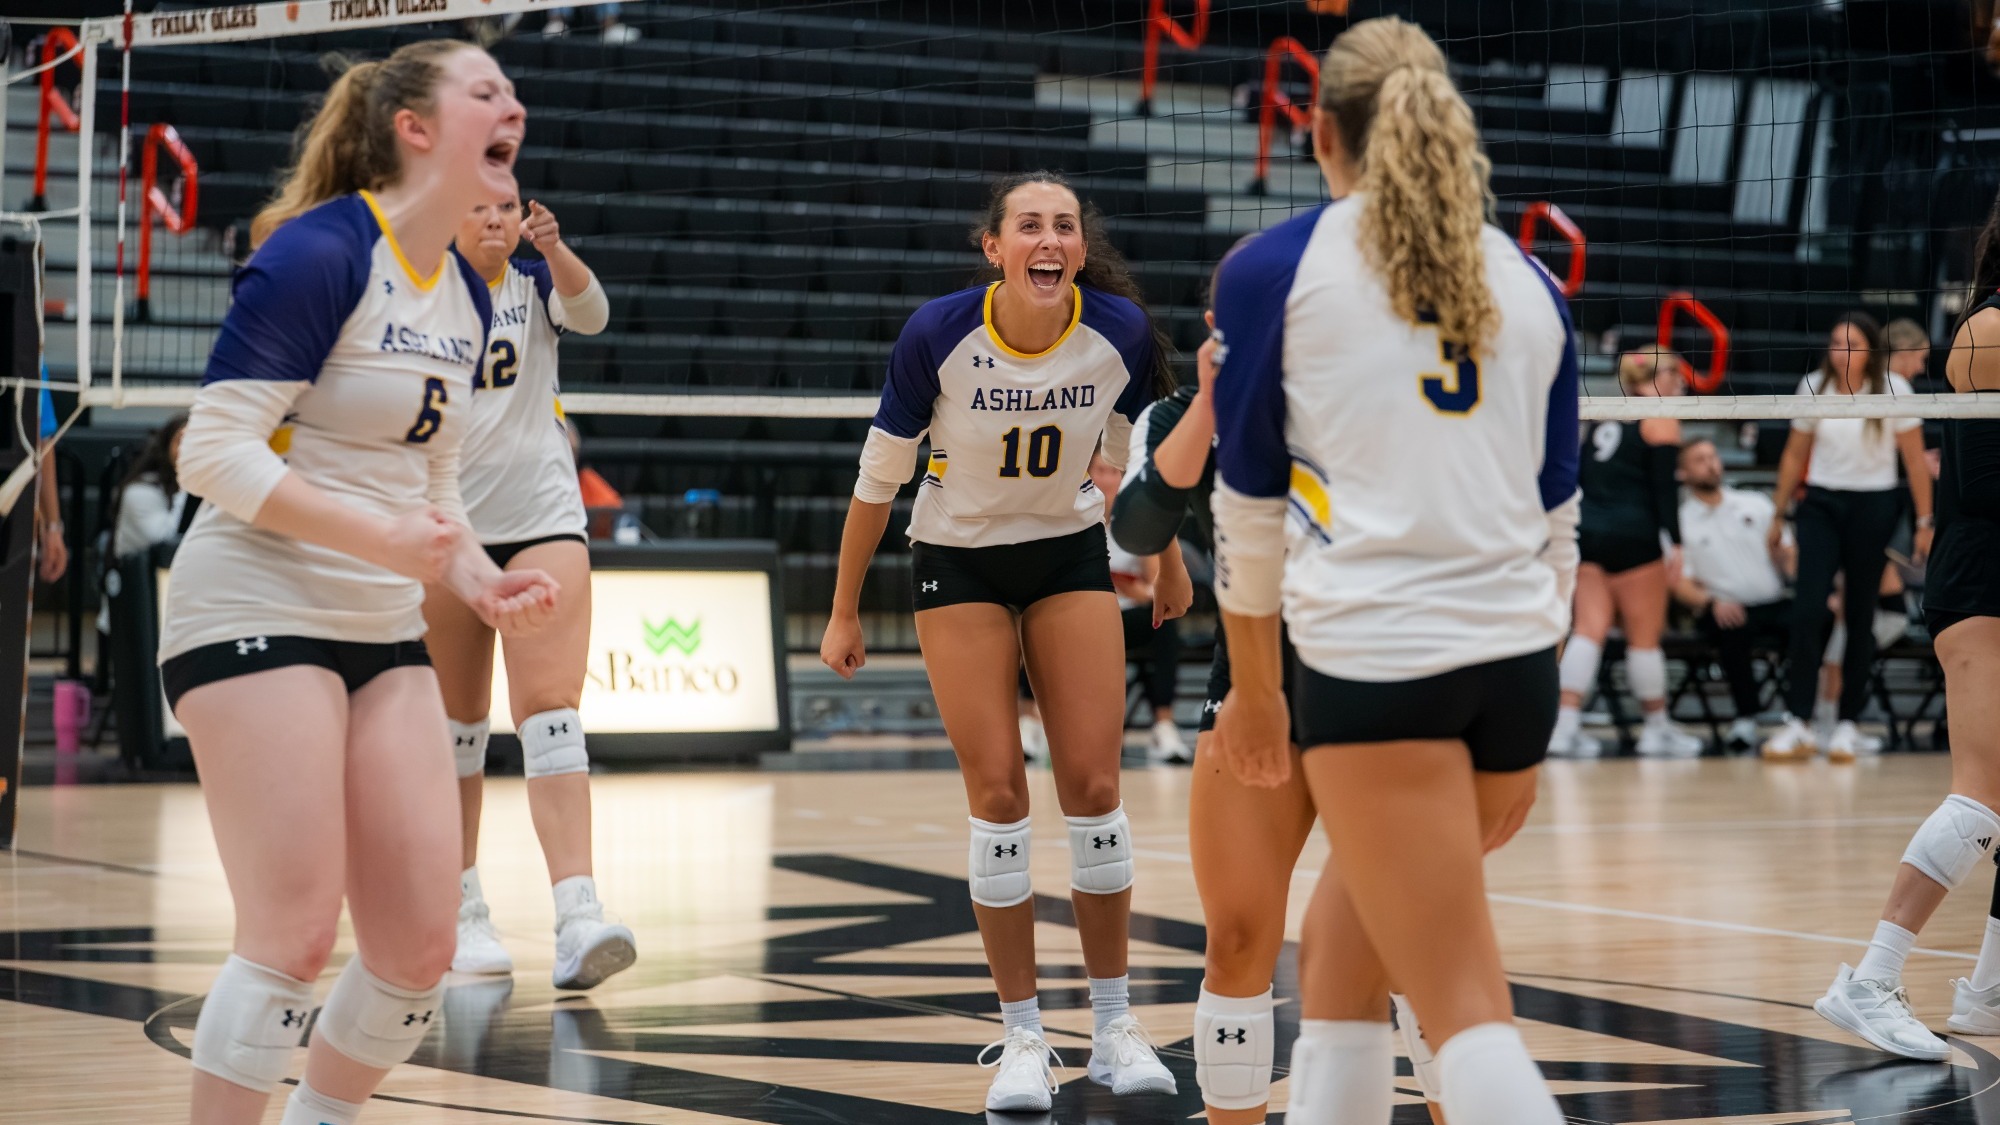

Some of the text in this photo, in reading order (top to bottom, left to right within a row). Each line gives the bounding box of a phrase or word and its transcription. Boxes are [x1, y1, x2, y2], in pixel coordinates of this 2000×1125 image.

[152, 5, 257, 37] FINDLAY OILERS
[404, 376, 448, 443] 6
[970, 384, 1095, 412] ASHLAND
[998, 423, 1063, 479] 10
[1592, 420, 1623, 463] 9
[585, 649, 740, 696] sBanco
